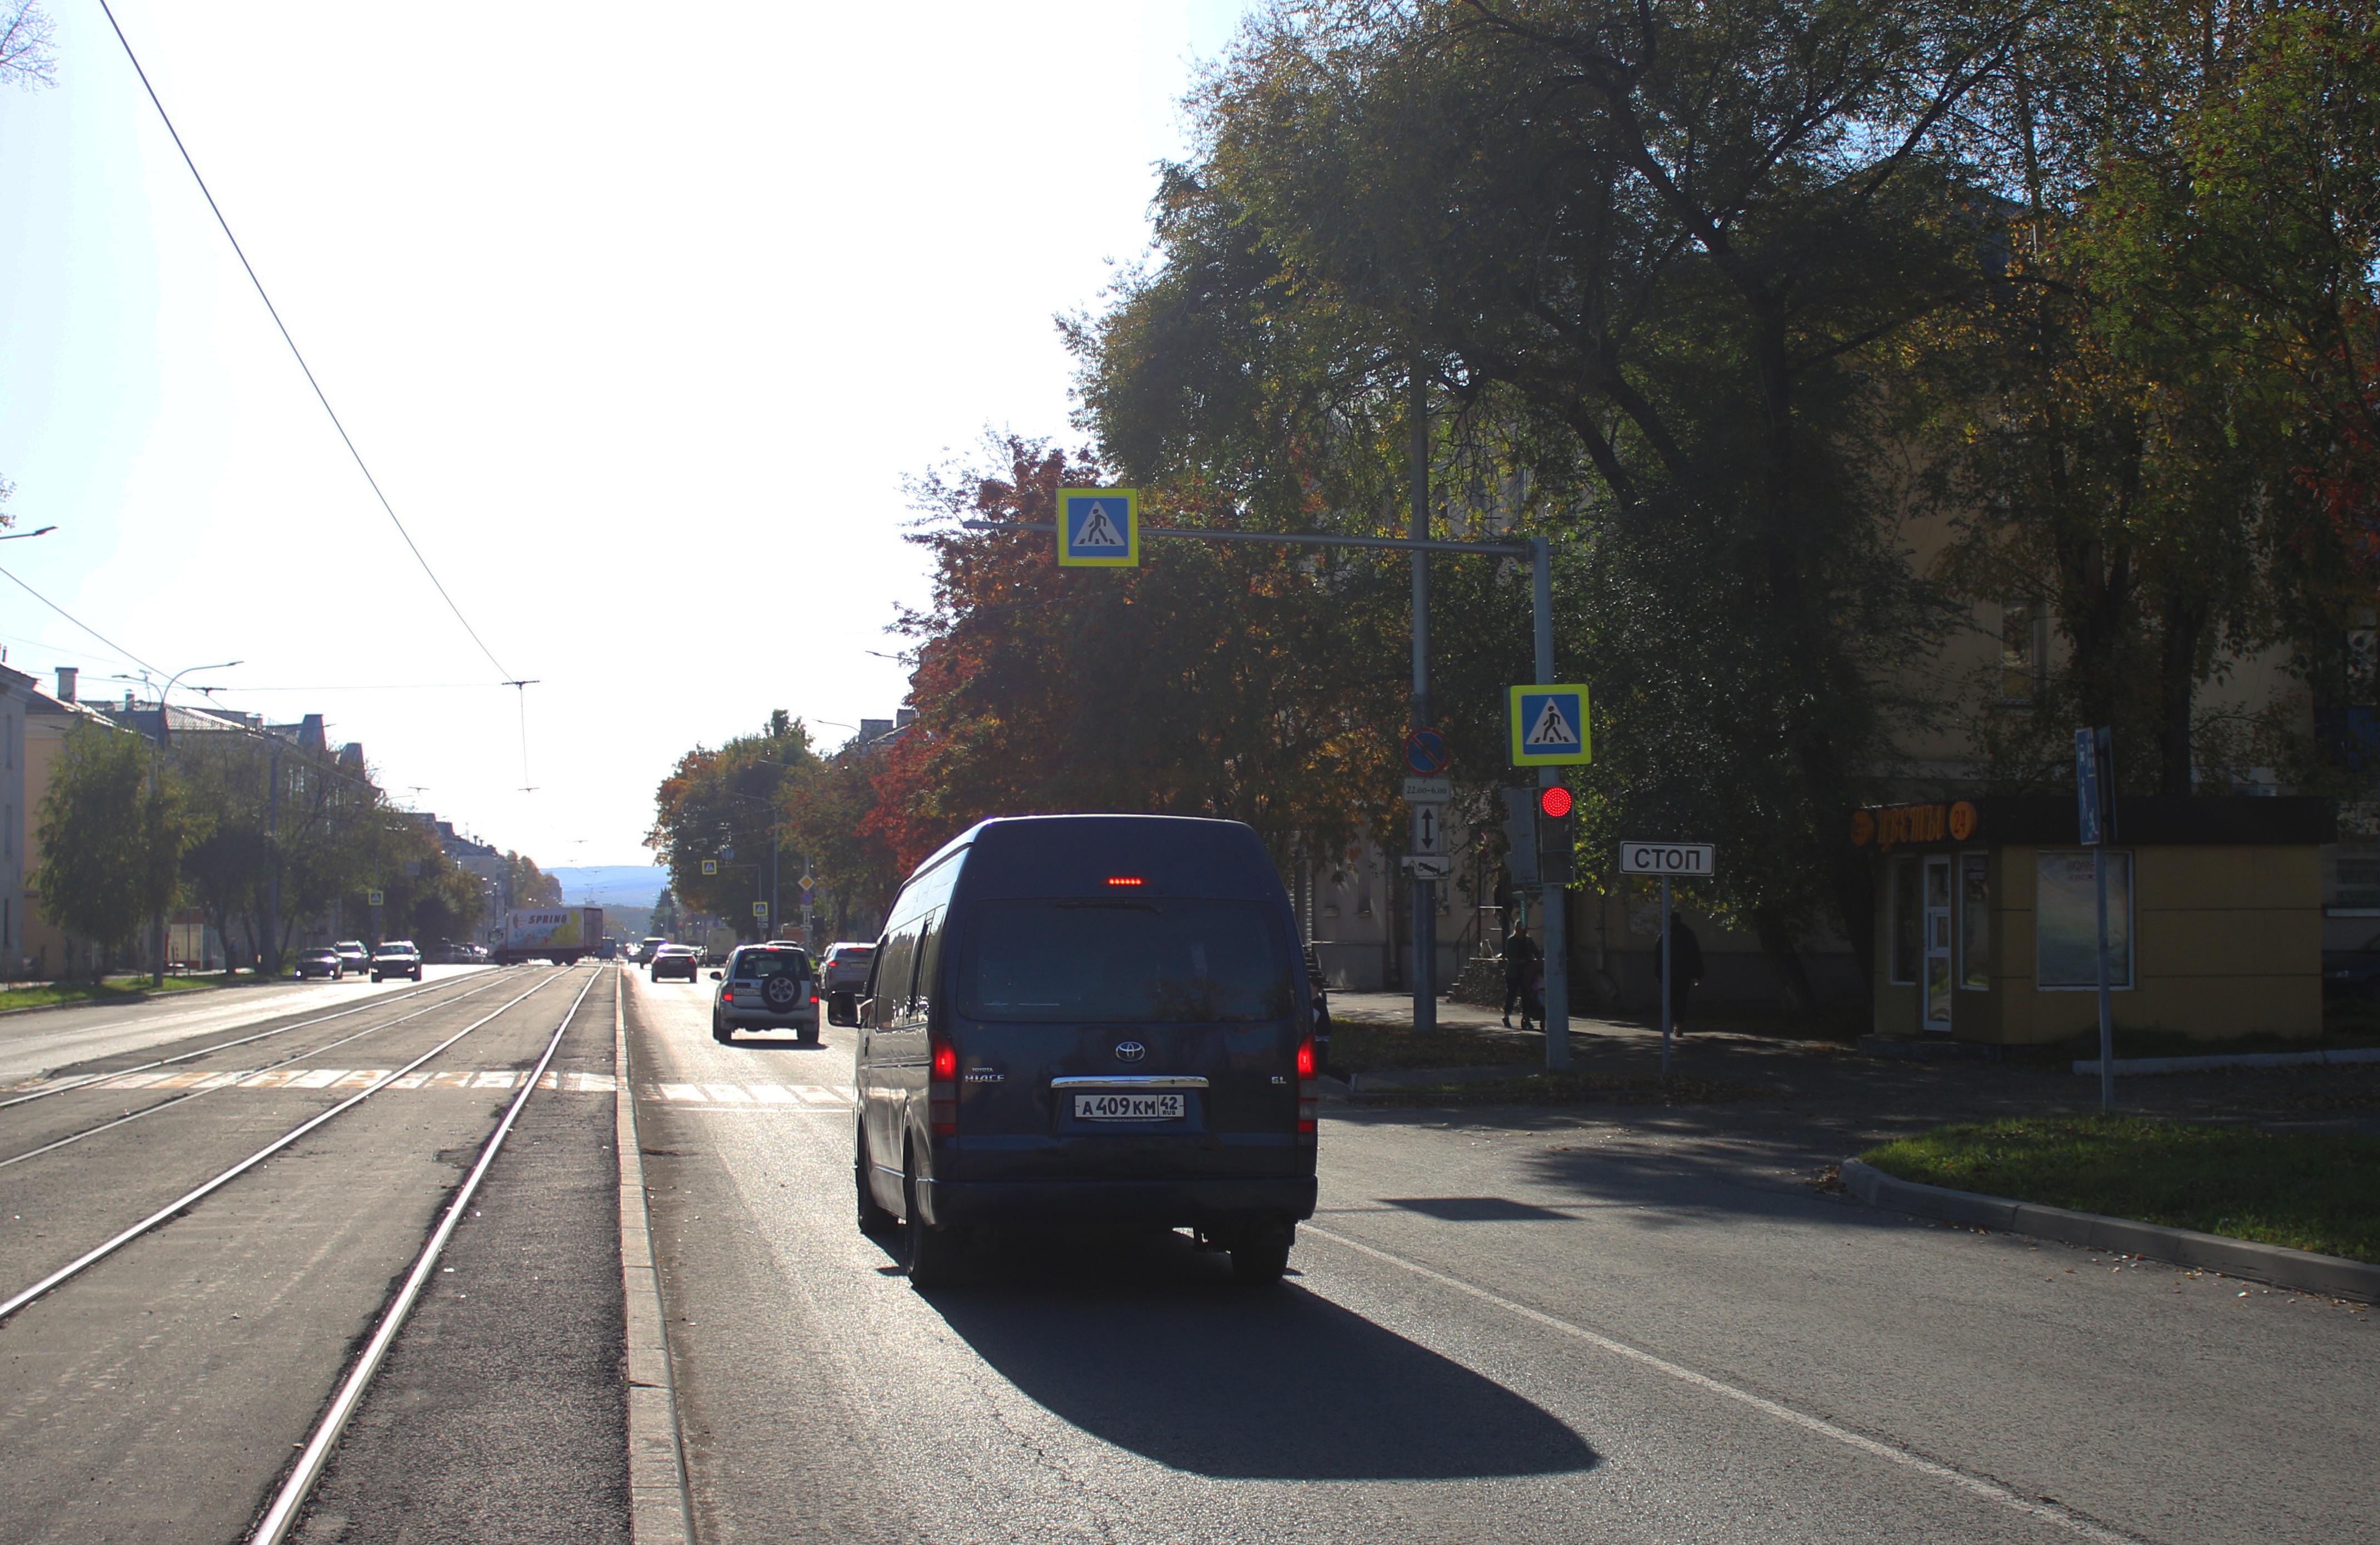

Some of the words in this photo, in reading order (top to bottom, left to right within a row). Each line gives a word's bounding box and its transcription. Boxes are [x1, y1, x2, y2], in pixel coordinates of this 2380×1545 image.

[1954, 809, 1967, 834] 24
[1635, 848, 1700, 870] СТОП
[528, 914, 568, 925] SPRING
[966, 1074, 1005, 1082] HIACE
[1160, 1096, 1178, 1110] 42
